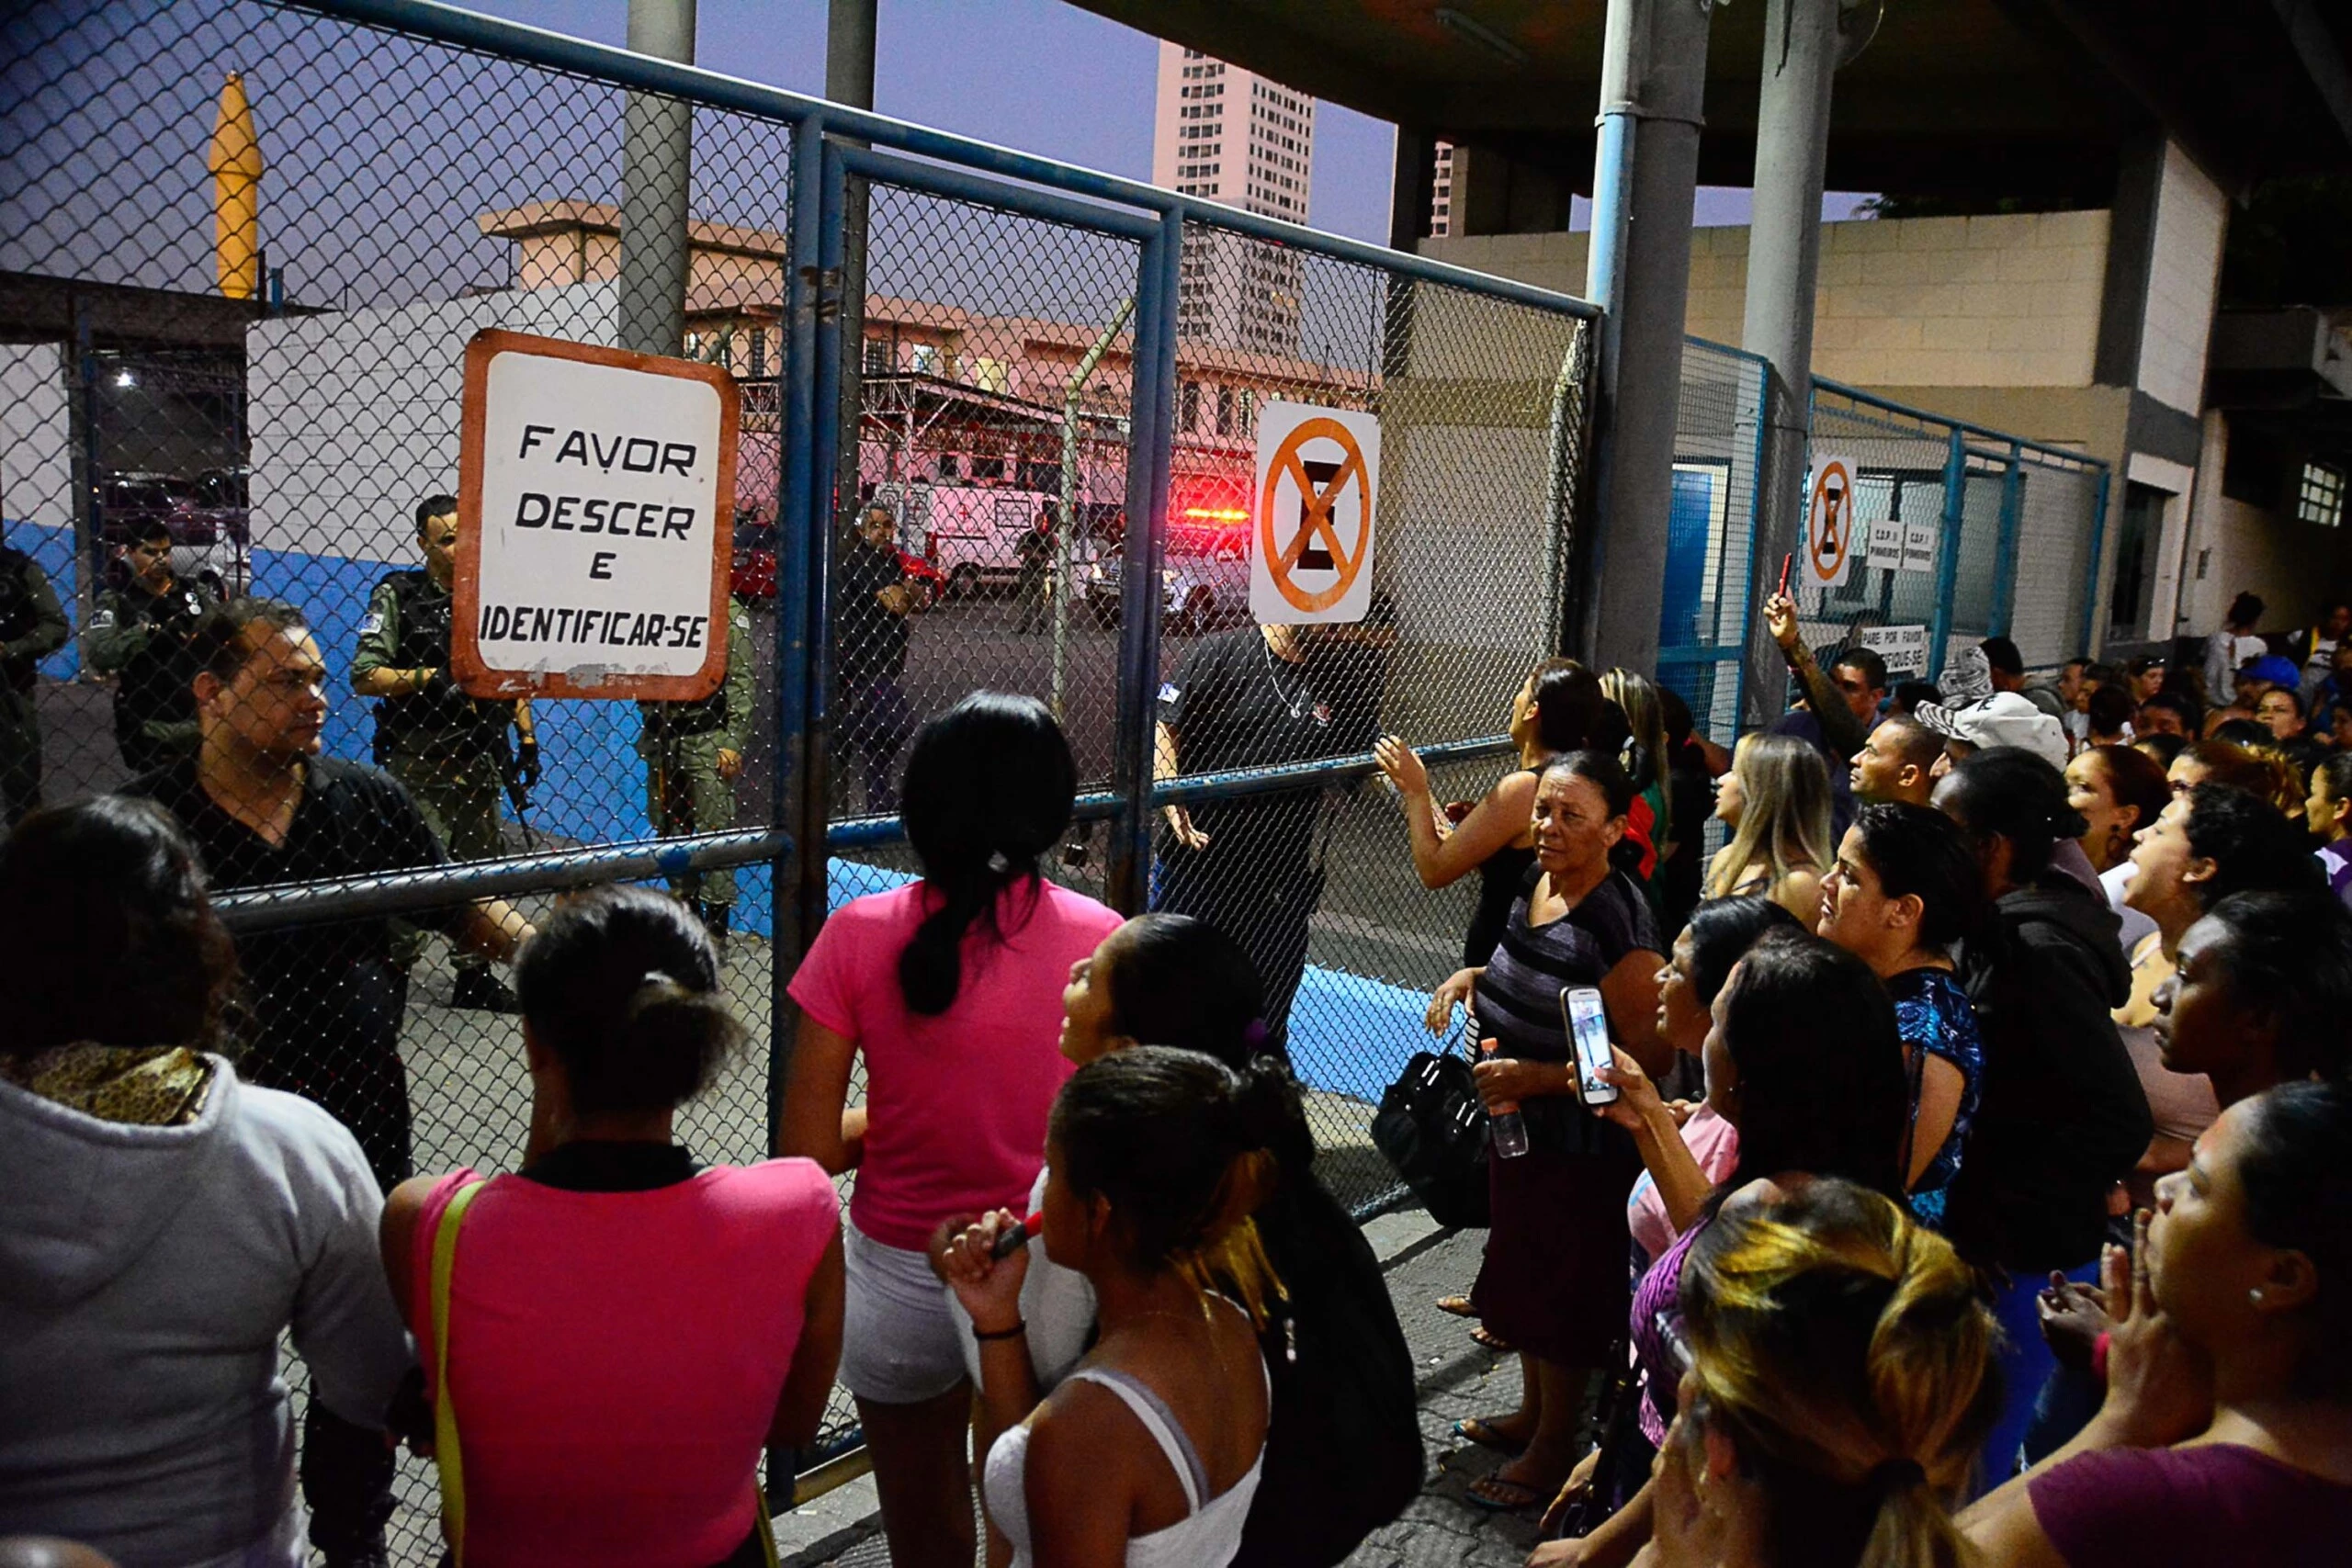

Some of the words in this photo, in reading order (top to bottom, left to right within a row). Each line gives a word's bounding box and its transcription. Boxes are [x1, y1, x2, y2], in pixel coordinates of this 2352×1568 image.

[519, 424, 696, 477] FAVOR
[515, 492, 695, 541] DESCER
[589, 552, 616, 580] E
[480, 604, 709, 649] IDENTIFICAR-SE
[1863, 631, 1881, 645] PARE
[1884, 631, 1898, 644] POR
[1902, 630, 1922, 644] FAVOR
